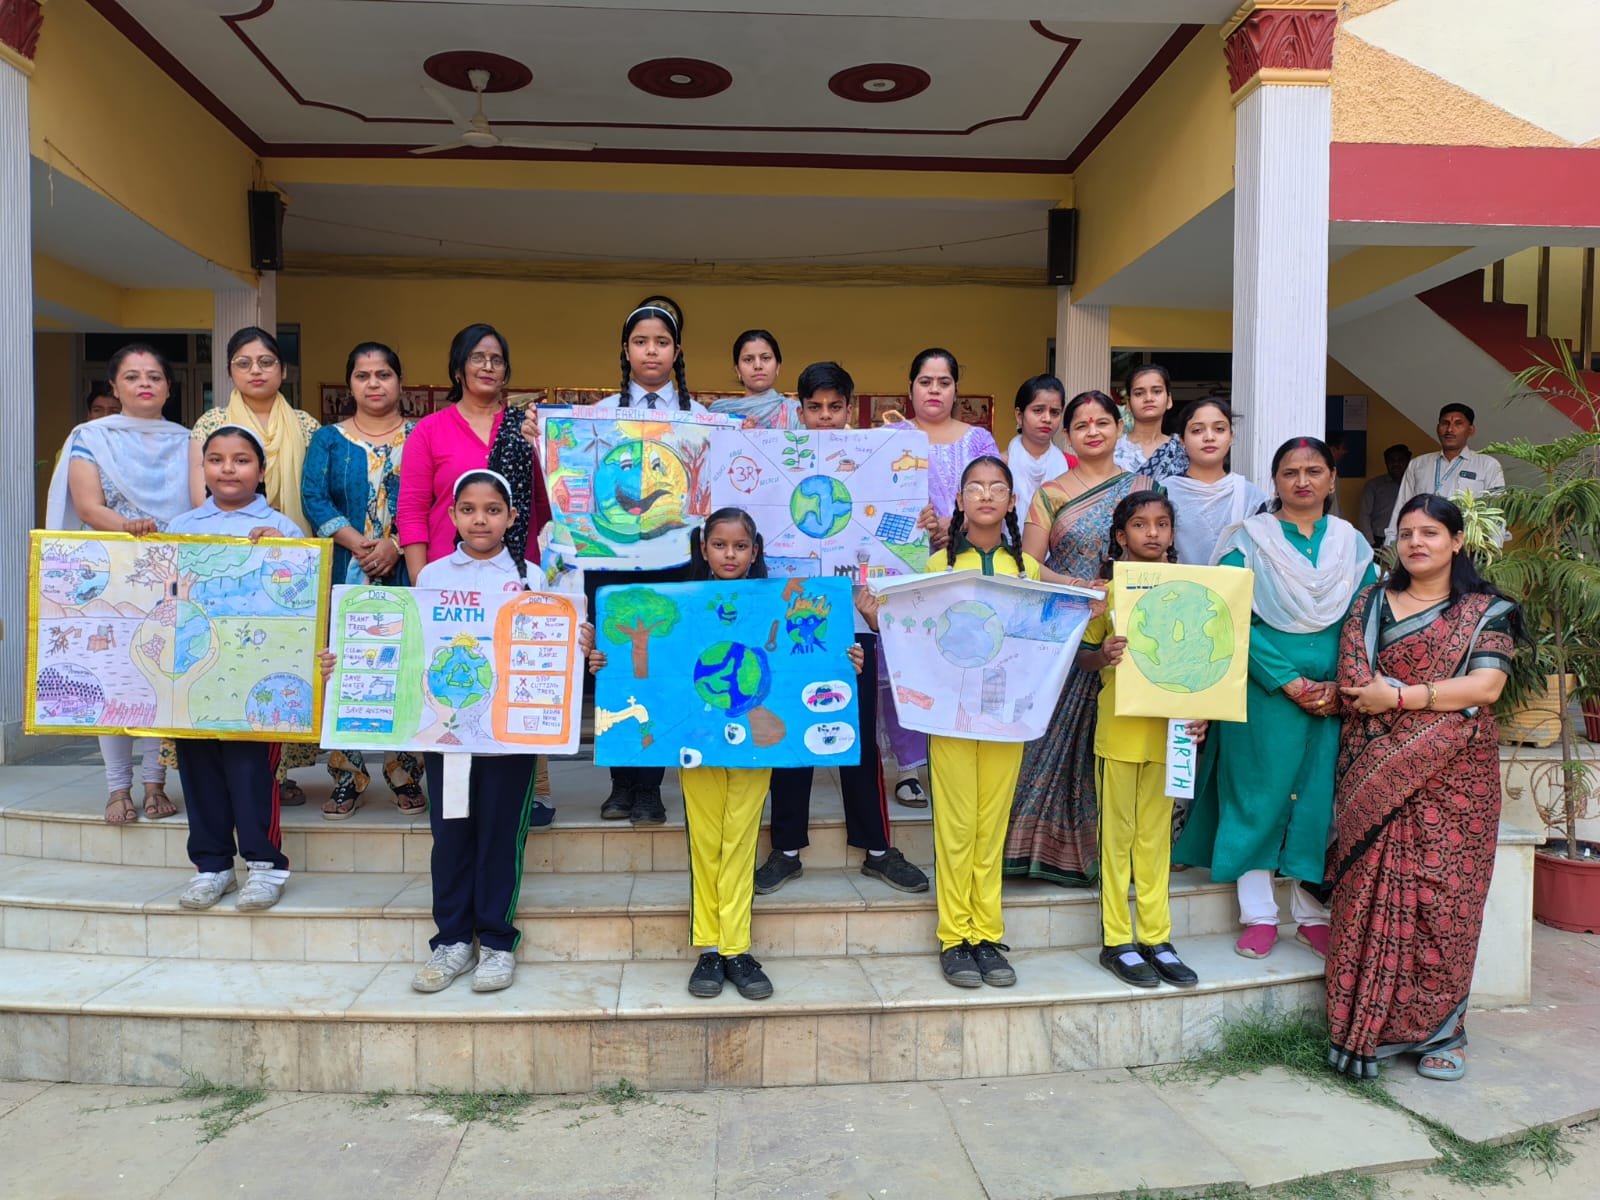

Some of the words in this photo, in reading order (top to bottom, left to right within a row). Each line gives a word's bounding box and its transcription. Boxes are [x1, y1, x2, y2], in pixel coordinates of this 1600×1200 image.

[616, 409, 645, 419] EARTH
[736, 466, 756, 482] 3R
[440, 590, 481, 606] SAVE
[432, 606, 484, 622] EARTH
[342, 682, 365, 690] WATER
[345, 706, 362, 714] SAVE
[1171, 724, 1192, 789] EARTH
